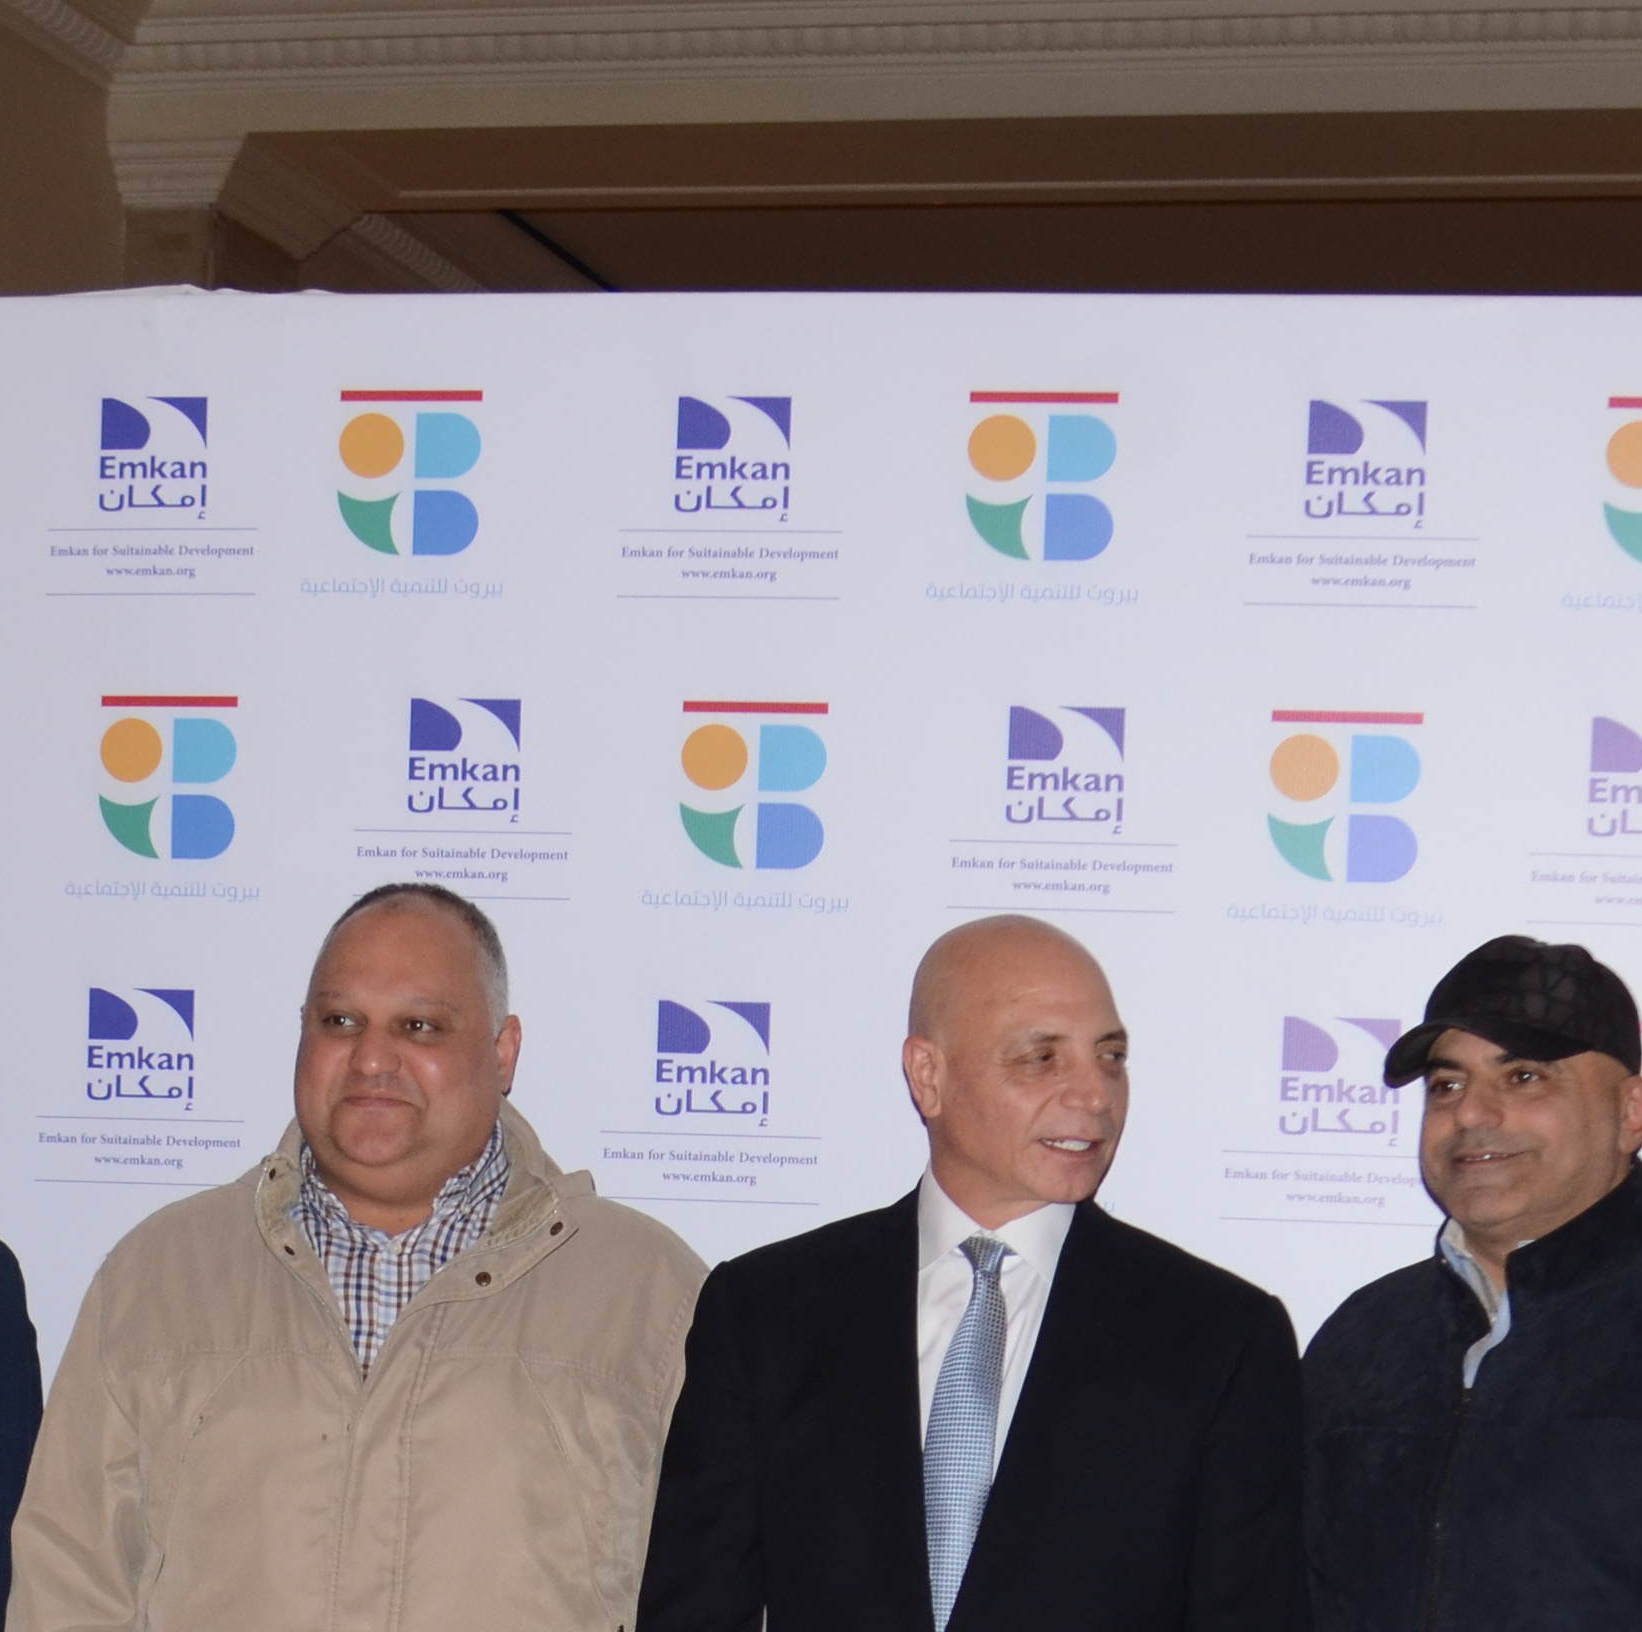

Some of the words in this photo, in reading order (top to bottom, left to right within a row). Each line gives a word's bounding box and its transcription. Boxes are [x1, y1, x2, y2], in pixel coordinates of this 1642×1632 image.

[100, 456, 207, 479] Emkan
[676, 456, 790, 480] Emkan
[1306, 461, 1425, 486] Emkan
[50, 546, 89, 556] Emkan
[92, 545, 109, 556] for
[178, 545, 254, 558] Development
[622, 546, 663, 557] Emkan
[667, 546, 685, 558] for
[759, 548, 838, 562] Development
[1249, 553, 1293, 565] Emkan
[1296, 553, 1315, 565] for
[1392, 554, 1476, 570] Development
[106, 565, 195, 579] www.emkan.org
[681, 568, 776, 582] www.emkan.org
[1311, 575, 1411, 590] www.emkan.org
[409, 757, 520, 782] Emkan
[1007, 766, 1124, 792] Emkan
[357, 846, 397, 857] Emkan
[401, 846, 419, 858] for
[490, 848, 568, 863] Development
[952, 857, 994, 869] Emkan
[998, 858, 1016, 869] for
[1092, 860, 1173, 875] Development
[413, 868, 508, 882] www.emkan.org
[1531, 870, 1576, 883] Emkan
[1579, 871, 1598, 883] for
[1012, 880, 1110, 895] www.emkan.org
[88, 1046, 194, 1070] Emkan
[656, 1059, 769, 1085] Emkan
[1280, 1076, 1400, 1105] Emkan
[39, 1132, 77, 1143] Emkan
[81, 1134, 97, 1144] for
[166, 1135, 240, 1150] Development
[94, 1154, 183, 1169] www.emkan.org
[603, 1148, 644, 1159] Emkan
[648, 1149, 666, 1160] for
[739, 1152, 817, 1167] Development
[662, 1171, 756, 1187] www.emkan.org
[1224, 1167, 1267, 1180] Emkan
[1271, 1169, 1290, 1180] for
[1286, 1192, 1385, 1208] www.emkan.org
